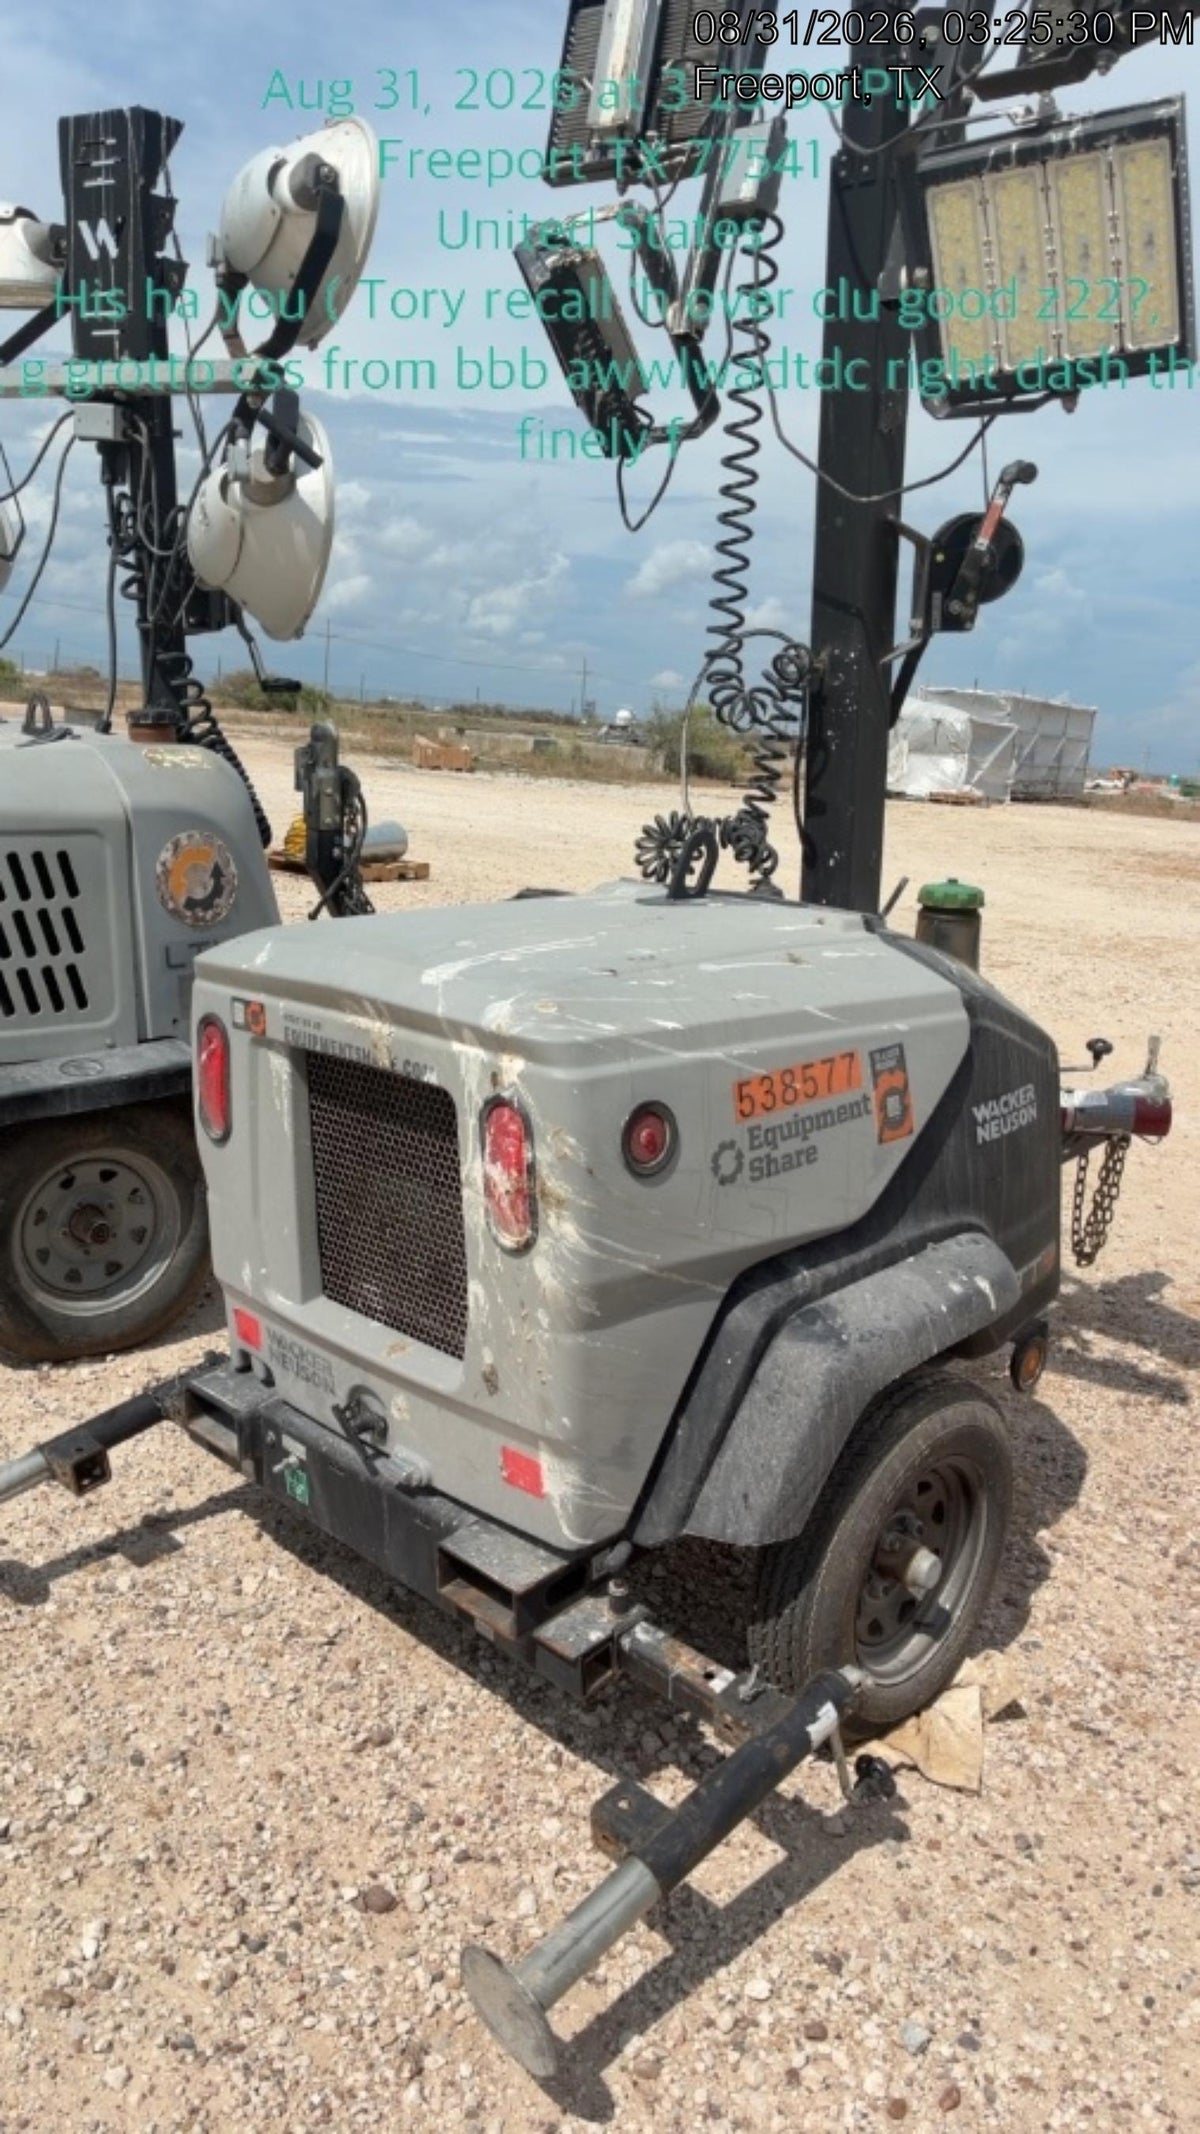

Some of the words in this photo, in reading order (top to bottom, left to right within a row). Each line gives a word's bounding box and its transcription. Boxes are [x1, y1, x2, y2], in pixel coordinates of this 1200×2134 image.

[738, 1053, 856, 1118] 538577
[972, 1083, 1036, 1124] WACKER
[747, 1094, 873, 1151] Equipment
[976, 1102, 1037, 1145] NEUSON
[748, 1144, 819, 1182] Share
